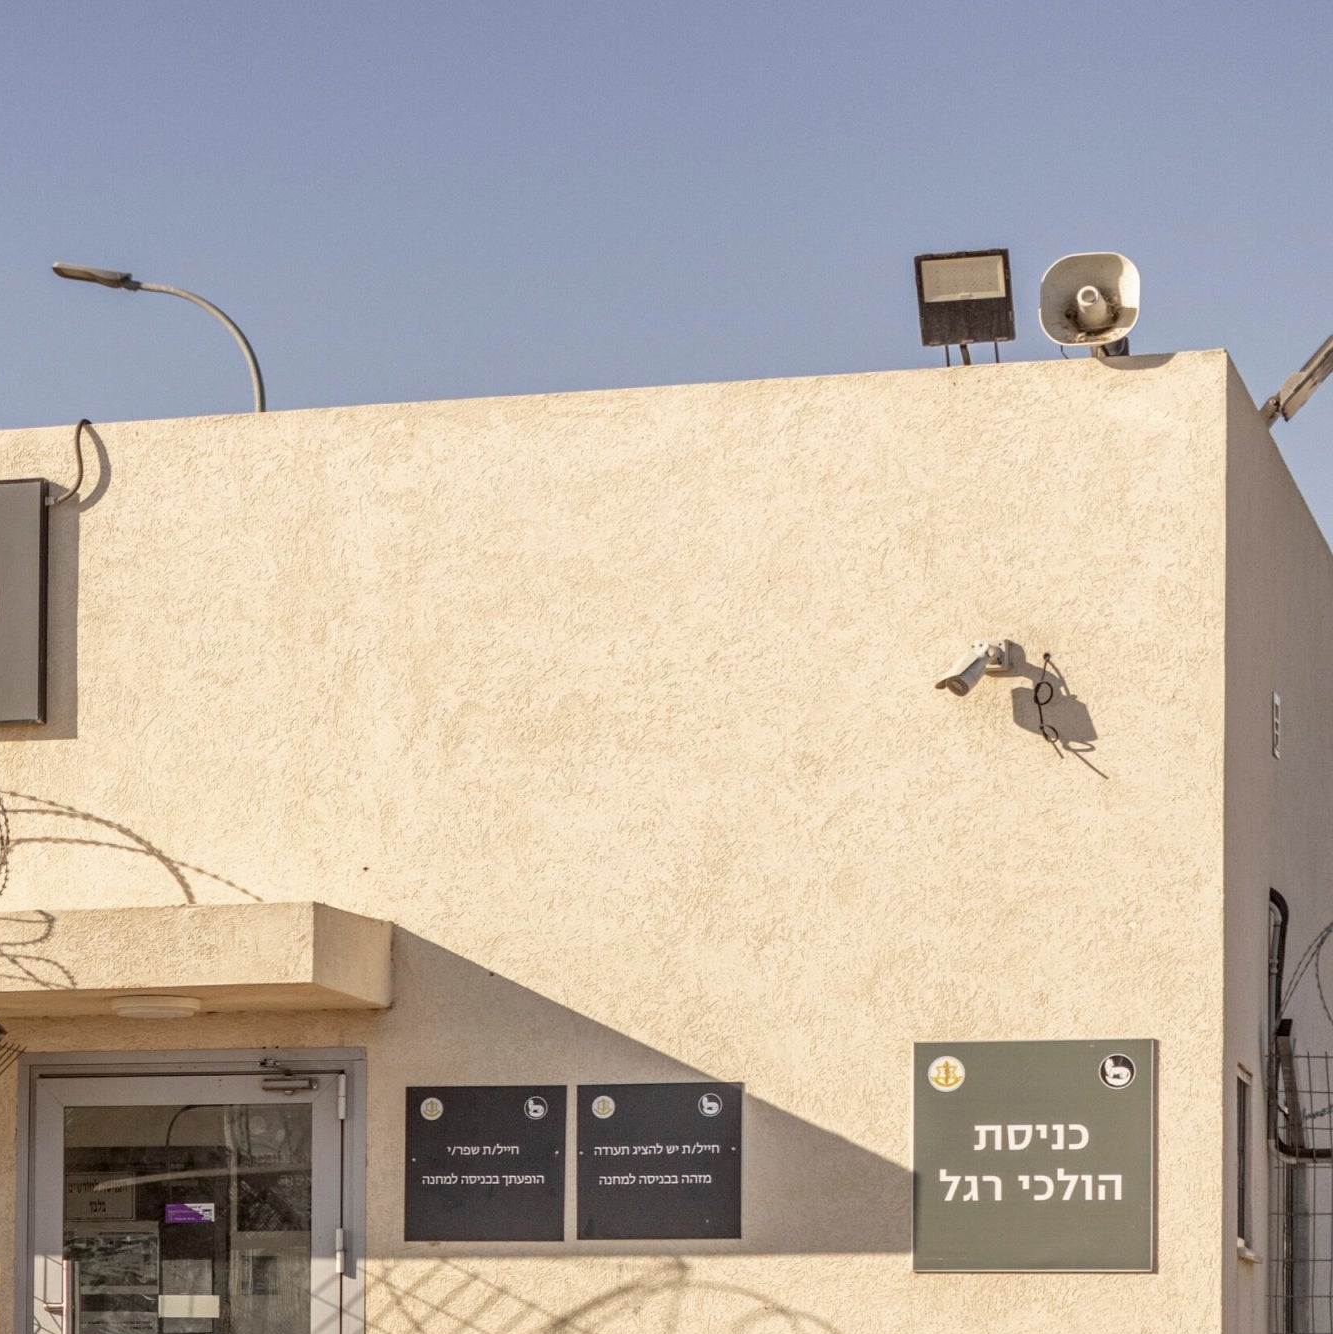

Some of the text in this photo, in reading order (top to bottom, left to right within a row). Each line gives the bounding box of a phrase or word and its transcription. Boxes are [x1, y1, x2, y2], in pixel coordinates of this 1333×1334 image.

[973, 1123, 1090, 1151] כניסת
[446, 1143, 520, 1156] חייל/ת שפר/י
[593, 1141, 721, 1156] חייל/ת יש להציג תעודה
[422, 1172, 545, 1187] הופעתך בכניסה למחנה
[599, 1172, 713, 1186] מזהה בכניסה למחנה
[939, 1167, 1123, 1202] הולכי רגל
